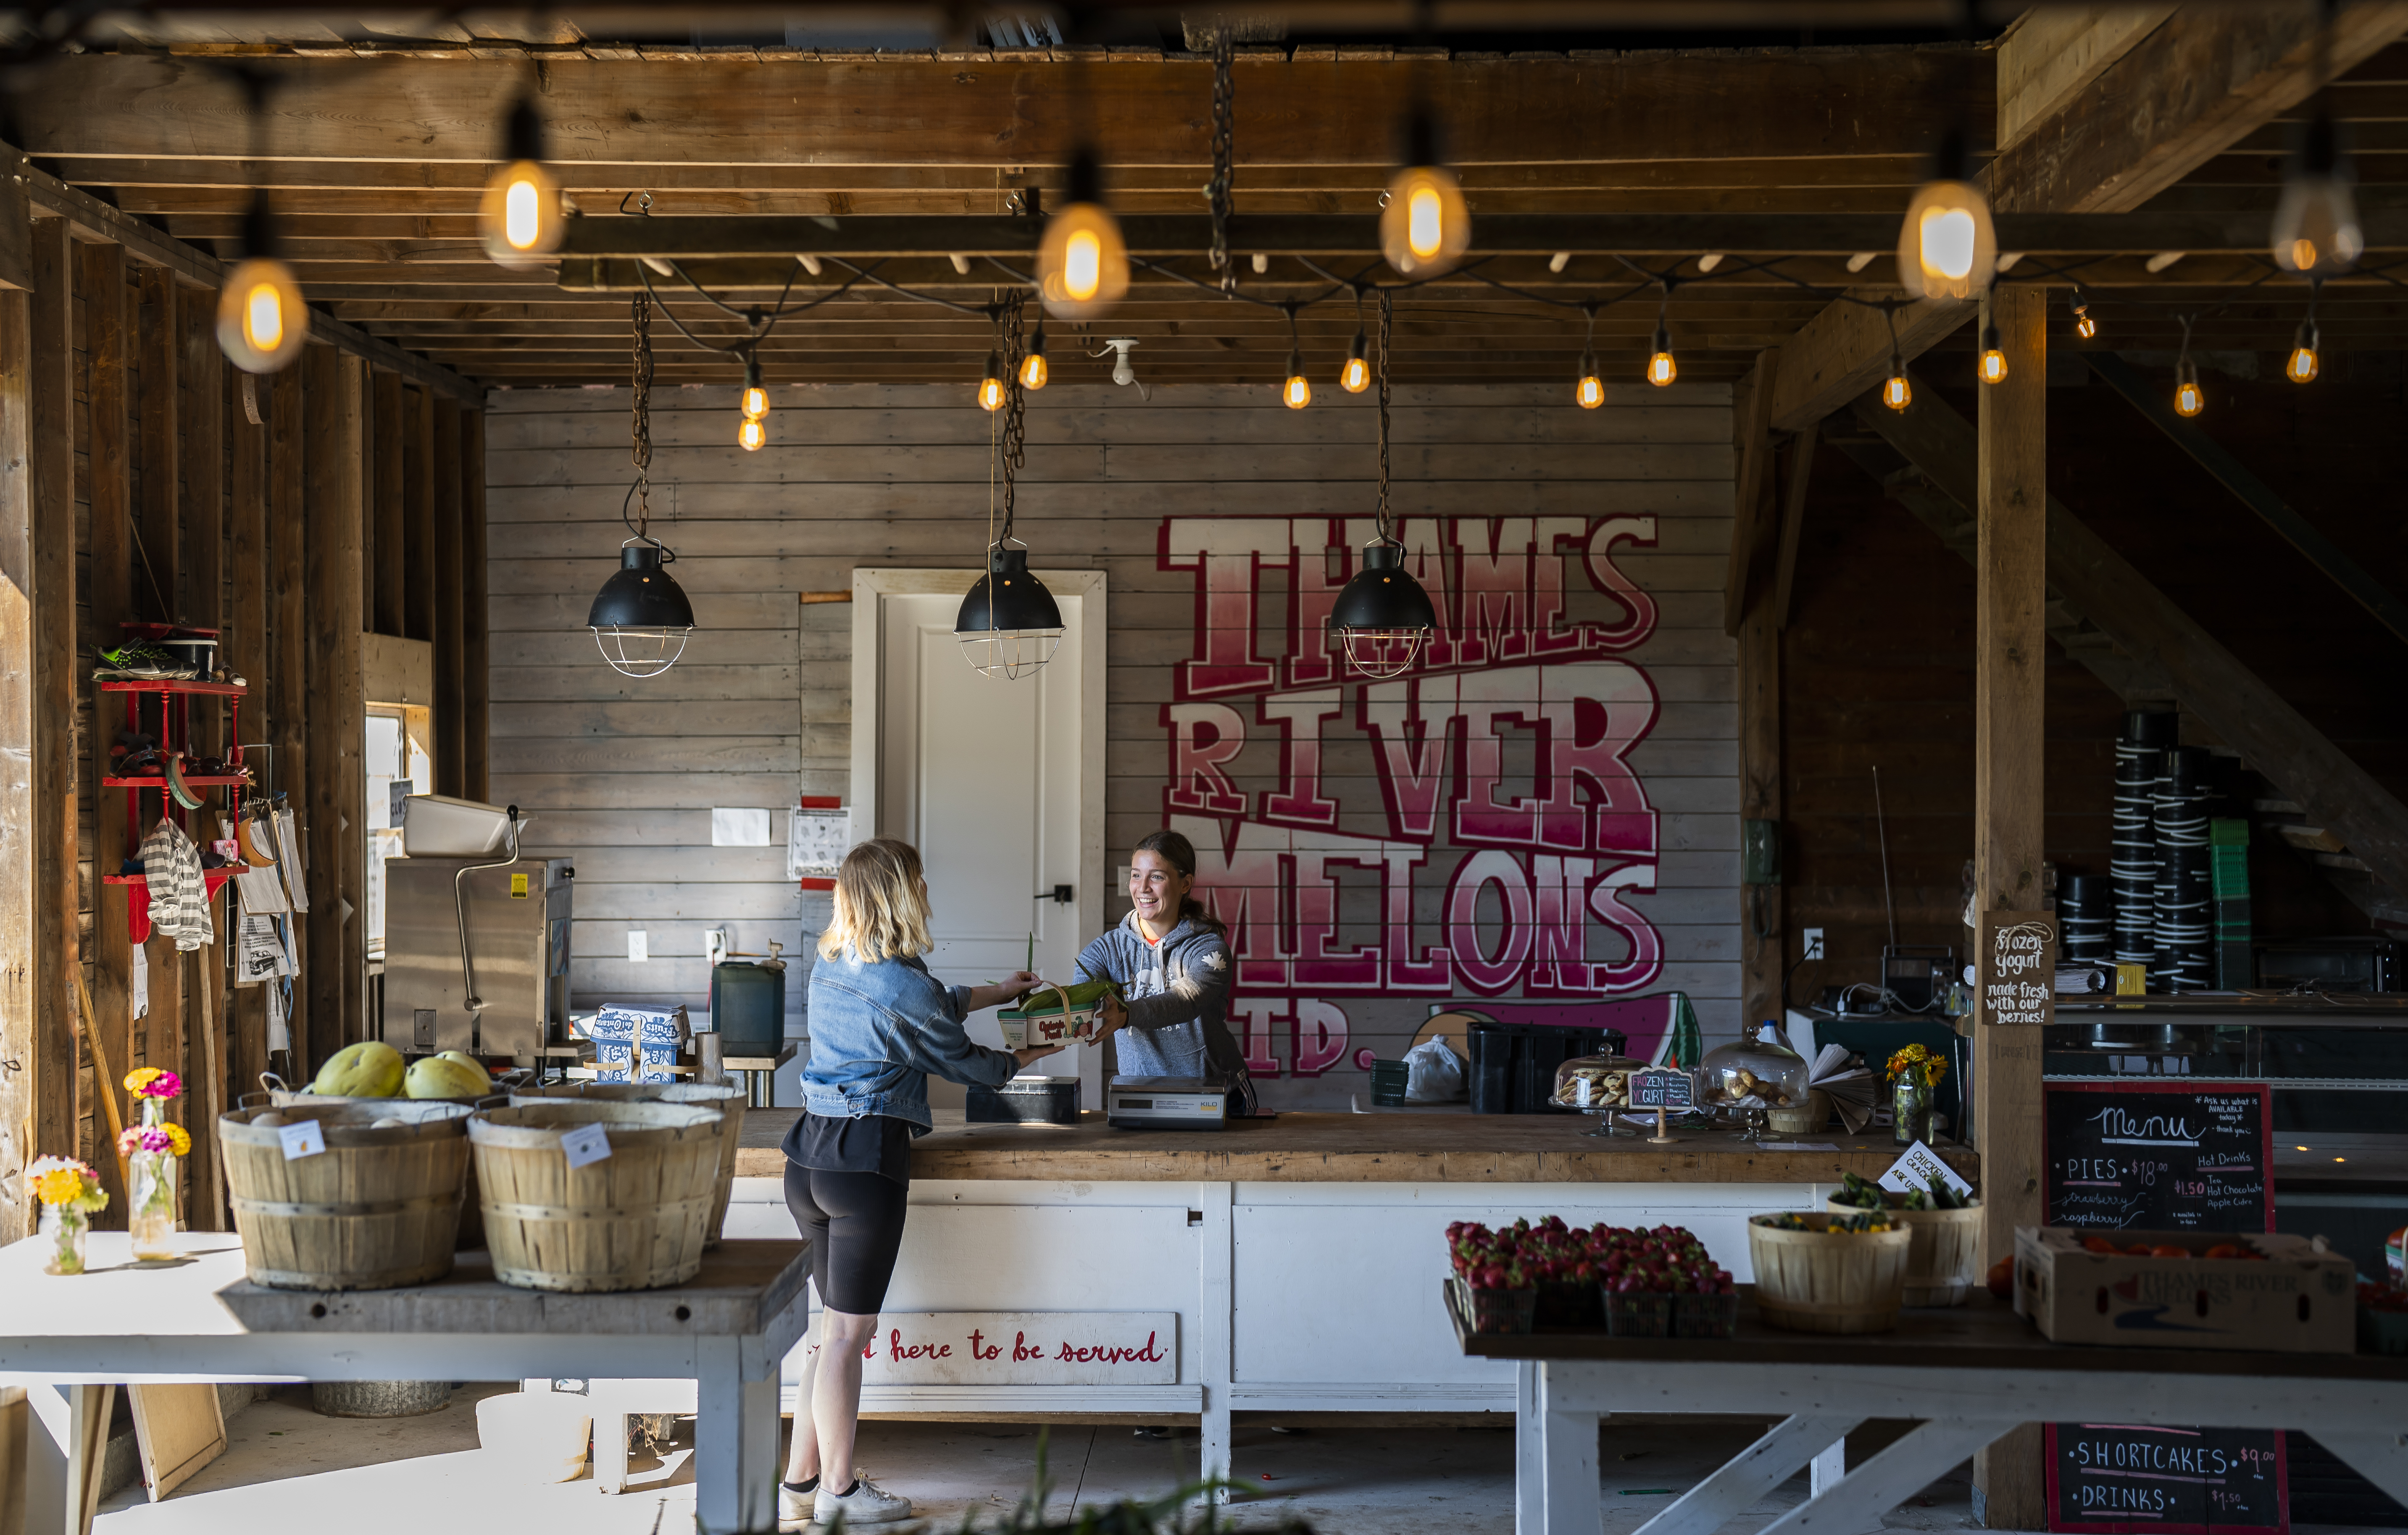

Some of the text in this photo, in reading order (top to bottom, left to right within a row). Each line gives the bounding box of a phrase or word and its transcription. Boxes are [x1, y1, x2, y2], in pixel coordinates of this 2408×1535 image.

[1158, 513, 1659, 697] THAMES
[1159, 653, 1661, 858] RIVER
[1163, 814, 1664, 995] MELONS
[1996, 929, 2043, 950] frozen
[1995, 949, 2043, 978] yogurt
[2019, 981, 2049, 1000] fresh
[1986, 996, 2042, 1010] with our
[1997, 1009, 2045, 1024] berries!
[646, 1023, 677, 1037] Fruits
[1039, 1019, 1066, 1032] Ontario
[1044, 1028, 1063, 1041] Fruit
[1230, 996, 1378, 1079] TD.
[1632, 1076, 1664, 1087] FROZEN
[1633, 1089, 1665, 1104] YOGURT
[2204, 1096, 2218, 1104] Ask
[2208, 1105, 2244, 1113] AVAILABLE
[2086, 1107, 2206, 1139] Menu
[2218, 1114, 2236, 1124] today
[2216, 1125, 2245, 1138] thank you
[1913, 1150, 1947, 1181] CHICKEN
[2198, 1151, 2251, 1167] Hot Drinks
[1891, 1169, 1908, 1183] ASK
[2068, 1159, 2168, 1186] PIES $18.00
[2207, 1175, 2222, 1185] Tea
[2174, 1179, 2205, 1195] $1.50
[2207, 1182, 2263, 1196] Hot Chocolate
[2056, 1192, 2141, 1212] strawberry
[2207, 1197, 2253, 1210] Apple Cidre
[2056, 1212, 2141, 1231] raspberry
[2141, 1270, 2297, 1293] THAMES RIVER
[890, 1328, 953, 1363] here
[967, 1328, 1003, 1360] to
[1013, 1330, 1045, 1363] be
[2078, 1442, 2275, 1474] SHORTCAKES $9.00
[2082, 1485, 2241, 1511] DRINKS $1.50
